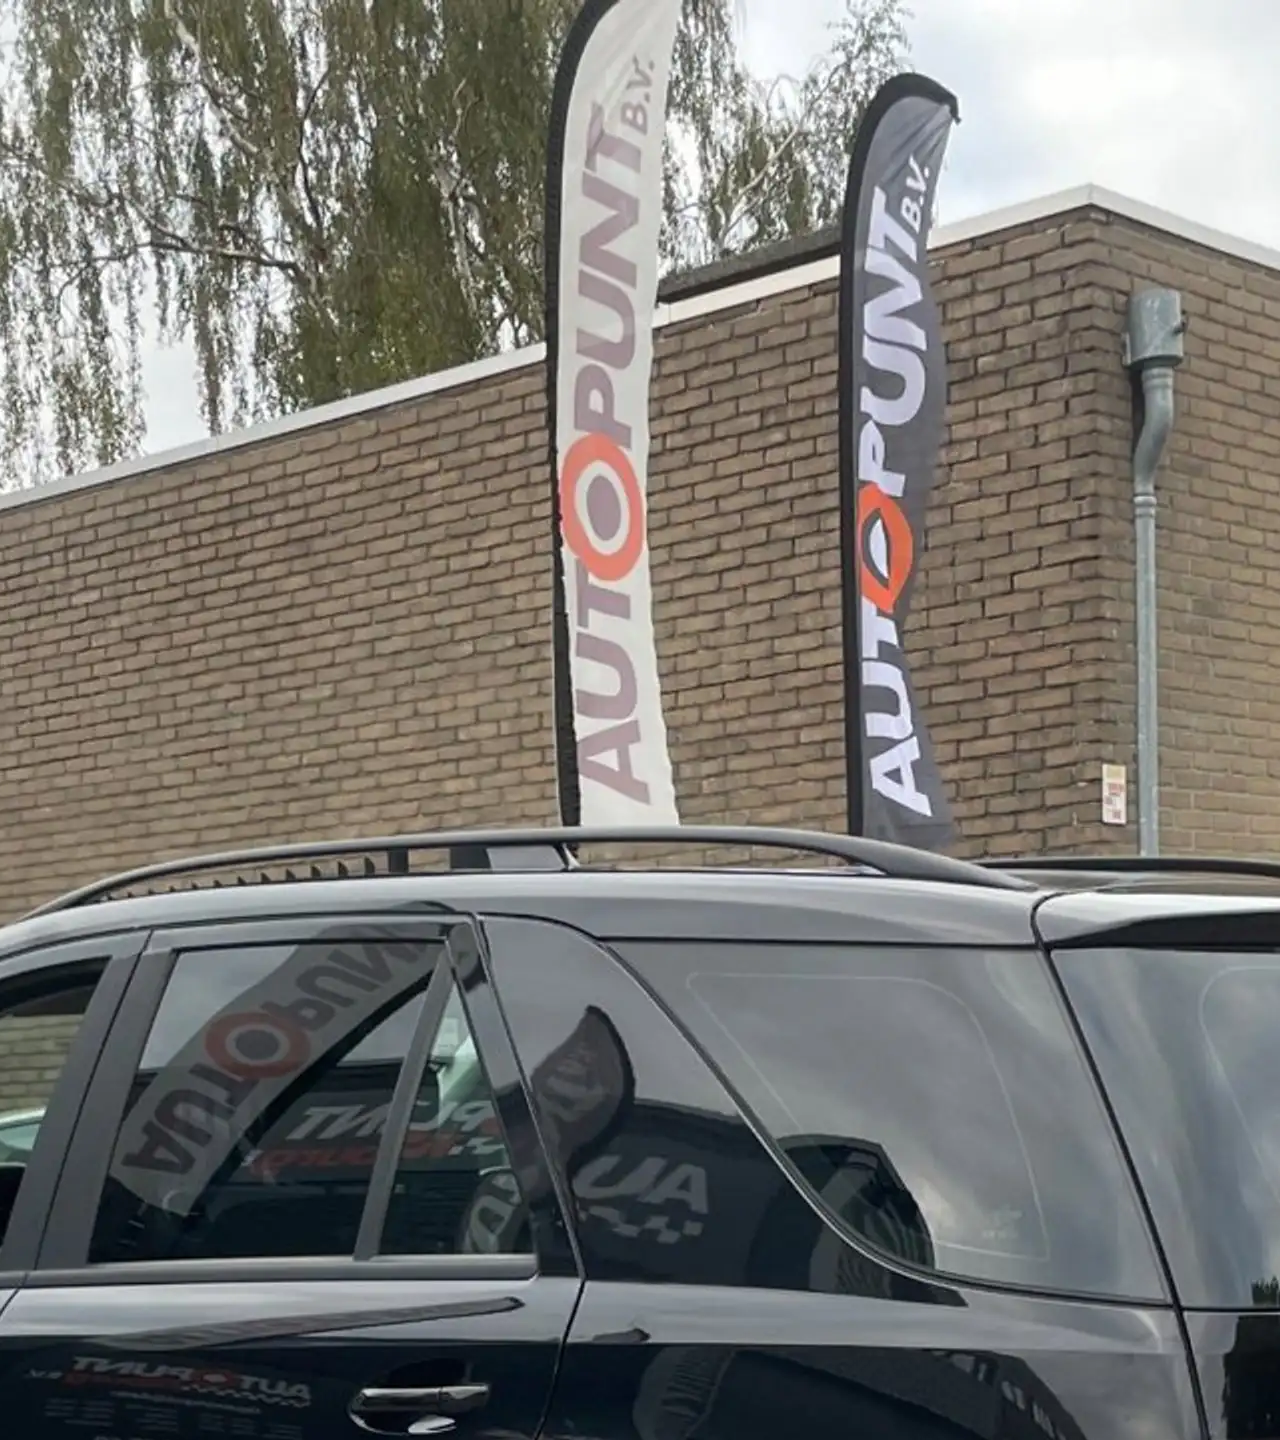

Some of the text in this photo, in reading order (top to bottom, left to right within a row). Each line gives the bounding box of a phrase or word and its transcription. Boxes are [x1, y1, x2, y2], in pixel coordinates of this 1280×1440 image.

[559, 56, 656, 806] AUTOPUNT B.V.
[857, 153, 933, 818] AUTOPUNT B.V.
